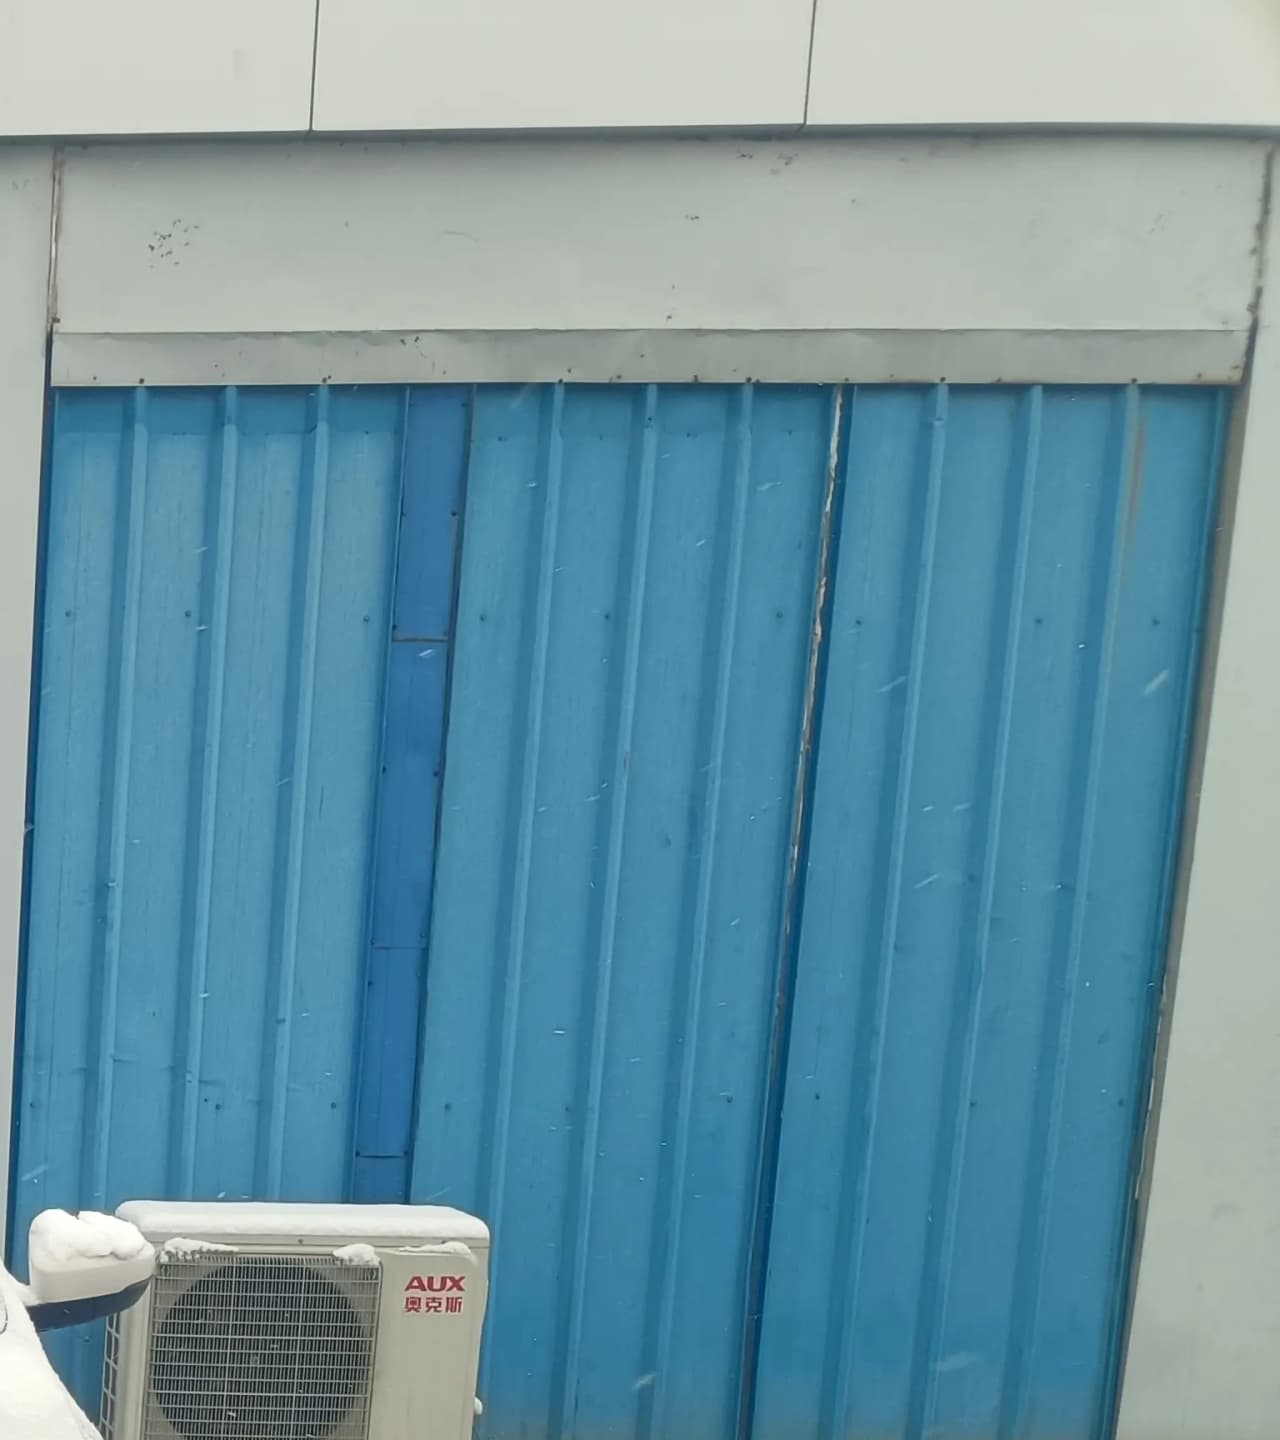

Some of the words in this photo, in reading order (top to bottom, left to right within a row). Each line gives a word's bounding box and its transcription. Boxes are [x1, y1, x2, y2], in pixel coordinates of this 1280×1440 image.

[404, 1275, 466, 1293] AUX
[405, 1296, 464, 1313] 奥克斯
